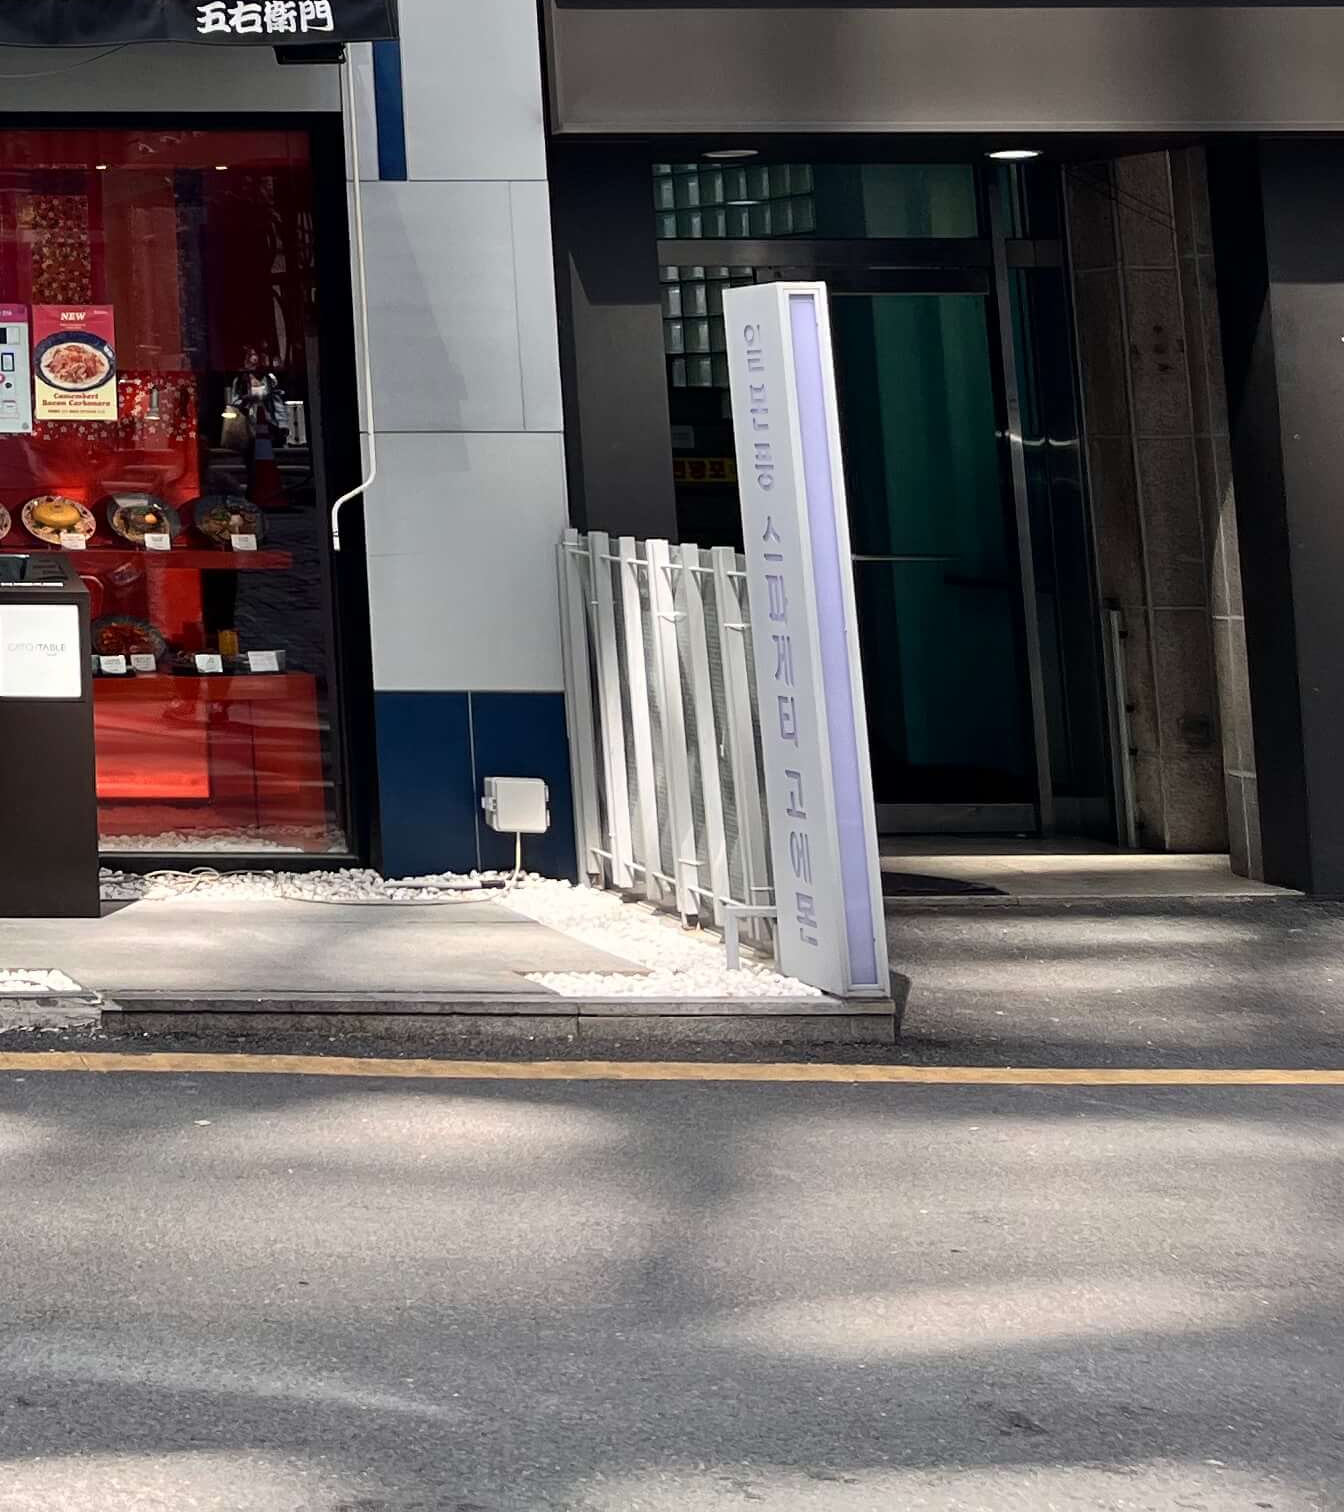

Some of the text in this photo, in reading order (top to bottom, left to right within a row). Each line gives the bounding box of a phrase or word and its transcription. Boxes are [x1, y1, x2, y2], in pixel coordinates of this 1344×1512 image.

[195, 0, 335, 34] 五右衛門
[60, 312, 86, 321] NEW
